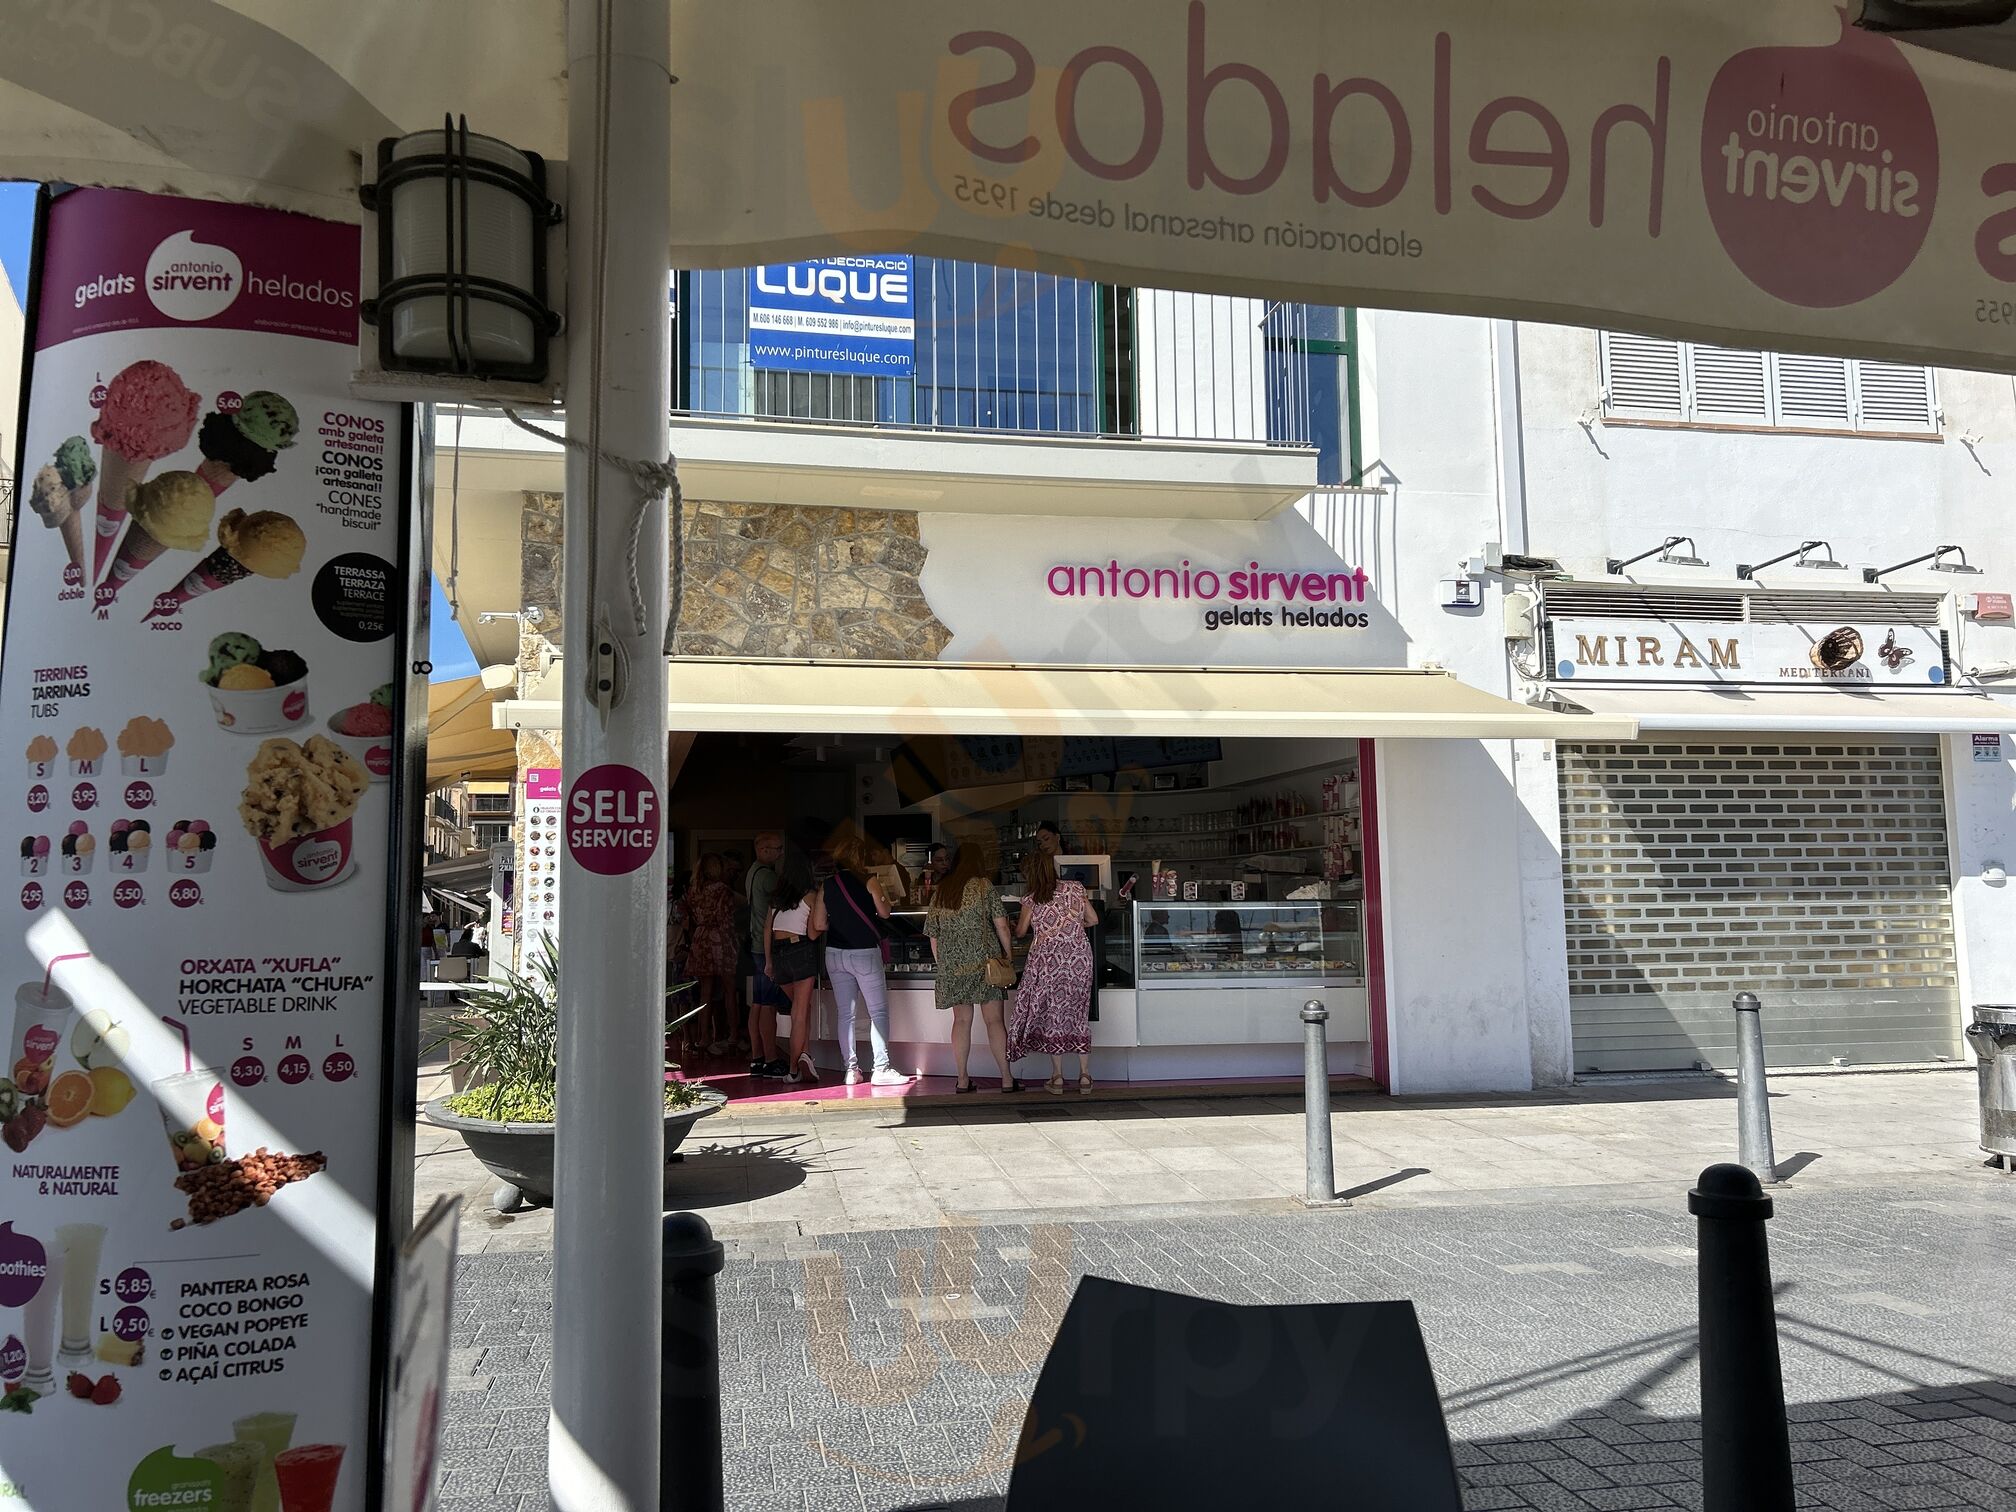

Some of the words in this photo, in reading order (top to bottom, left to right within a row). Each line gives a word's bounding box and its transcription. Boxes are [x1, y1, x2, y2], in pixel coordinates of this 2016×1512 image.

[171, 260, 223, 273] antonio
[152, 271, 234, 291] sirvent
[248, 271, 354, 308] helados
[756, 265, 908, 304] LUQUE
[74, 273, 136, 308] gelats
[755, 345, 910, 365] www.pinturesluque.com
[218, 397, 242, 410] 5,60
[324, 412, 384, 433] CONOS
[318, 427, 345, 438] amb
[348, 431, 384, 444] galeta
[324, 439, 384, 455] artesana!!
[322, 450, 384, 471] CONOS
[315, 465, 340, 476] ¡con
[344, 469, 383, 482] galleta
[322, 477, 383, 493] artesana!!
[328, 490, 382, 510] CONES
[334, 565, 386, 580] TERRASSA
[1049, 560, 1221, 600] antonio
[1228, 561, 1369, 602] sirvent
[339, 577, 386, 590] TERRAZA
[58, 588, 85, 601] doble
[343, 588, 385, 601] TERRACE
[154, 599, 178, 611] 3,25
[97, 609, 110, 620] M
[1205, 605, 1273, 630] gelats
[1282, 606, 1369, 628] helados
[1575, 634, 1741, 670] MIRAM
[34, 665, 88, 683] TERRINES
[32, 683, 90, 701] TARRINAS
[30, 703, 60, 719] TUBS
[36, 762, 45, 777] S
[78, 761, 93, 774] M
[139, 758, 149, 772] L
[28, 792, 48, 805] 3,20
[73, 790, 96, 803] 3,95
[126, 789, 153, 803] 5,30
[572, 790, 654, 824] SELF
[572, 828, 653, 848] SERVICE
[30, 859, 38, 873] 2
[72, 857, 81, 871] 3
[122, 855, 133, 869] 4
[185, 855, 195, 869] 5
[297, 850, 338, 868] sirvent
[22, 889, 42, 902] 2,95
[65, 889, 88, 902] 4,35
[115, 888, 141, 901] 5,50
[171, 887, 199, 901] 6,80
[180, 959, 256, 975] ORXATA
[179, 978, 286, 995] HORCHATA
[178, 997, 276, 1015] VEGETABLE
[282, 996, 338, 1012] DRINK
[242, 1037, 253, 1051] S
[285, 1036, 302, 1050] M
[335, 1034, 344, 1047] L
[232, 1065, 263, 1077] 3,30
[281, 1062, 307, 1075] 4,15
[325, 1061, 353, 1073] 5,50
[12, 1164, 120, 1180] NATURALMENTE
[38, 1182, 50, 1195] &
[53, 1181, 119, 1196] NATURAL
[0, 1260, 47, 1277] oothies
[100, 1279, 111, 1294] S
[116, 1278, 150, 1295] 5,85
[181, 1279, 257, 1298] PANTERA
[263, 1273, 310, 1290] ROSA
[179, 1302, 232, 1319] COCO
[237, 1294, 303, 1314] BONGO
[101, 1317, 108, 1332] L
[113, 1318, 148, 1334] 9,50
[178, 1321, 239, 1339] VEGAN
[245, 1314, 309, 1332] POPEYE
[177, 1342, 218, 1361] PIÑA
[224, 1336, 296, 1356] COLADA
[176, 1361, 218, 1384] AÇAÍ
[223, 1358, 284, 1377] CITRUS
[134, 1488, 212, 1507] freezers
